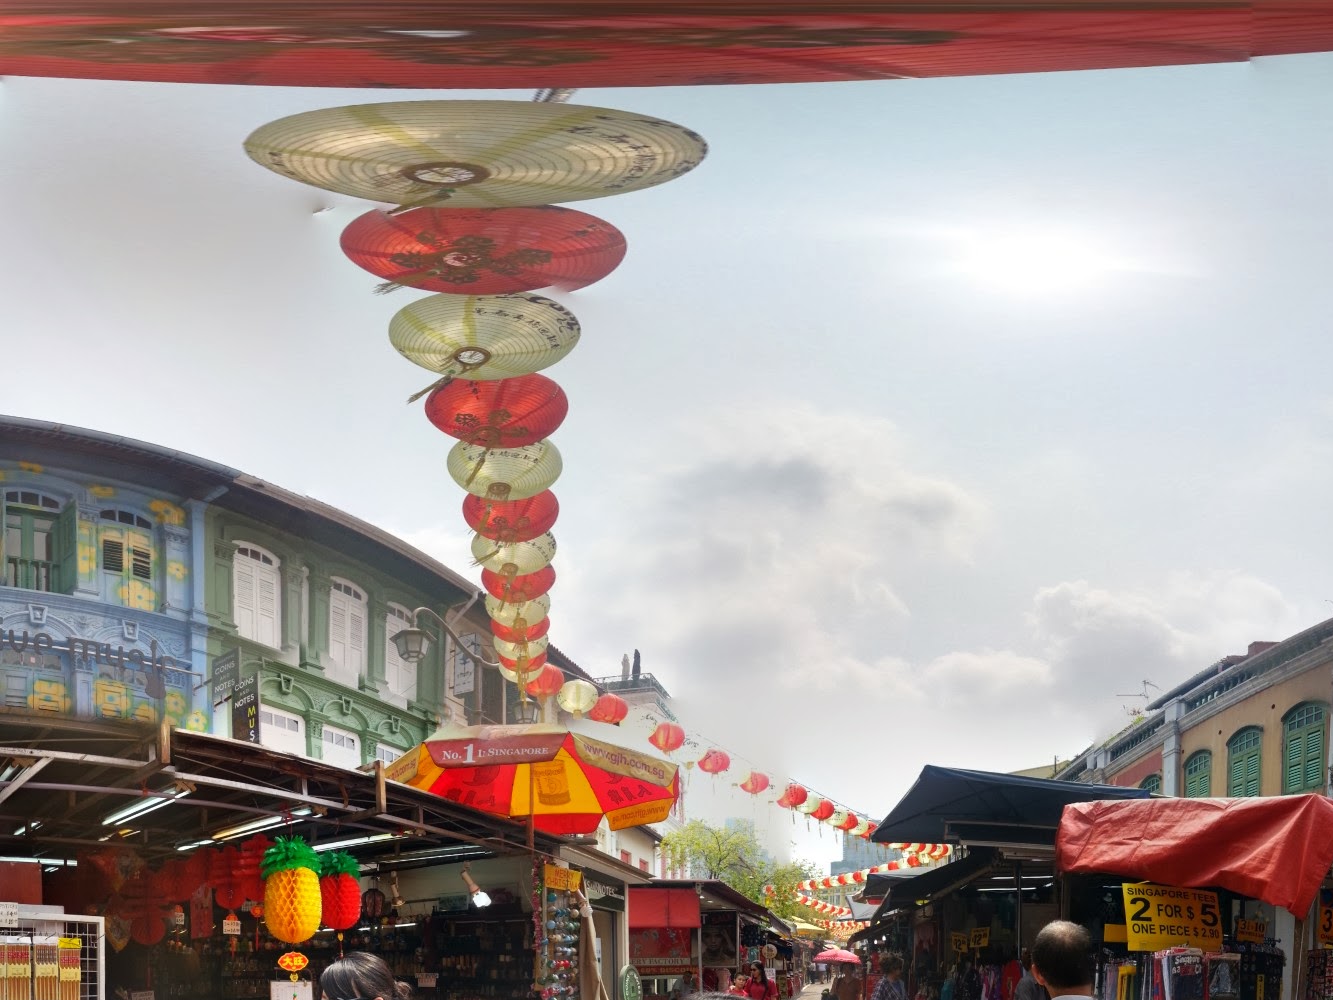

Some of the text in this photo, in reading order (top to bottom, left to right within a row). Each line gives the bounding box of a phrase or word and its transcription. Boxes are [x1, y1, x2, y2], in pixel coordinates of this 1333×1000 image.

[214, 660, 236, 676] COINS
[214, 678, 236, 694] NOTES
[234, 675, 254, 692] COINS
[234, 693, 255, 709] NOTES
[443, 744, 549, 764] No. 1 SINGAPORE
[555, 868, 575, 878] MERRY
[1127, 888, 1216, 903] SINGAPORE TEES
[1130, 897, 1218, 927] 2 FOR $ 5
[1240, 920, 1247, 930] 3
[1322, 909, 1332, 932] 3
[1132, 924, 1219, 939] ONE PIECE $ 2.90
